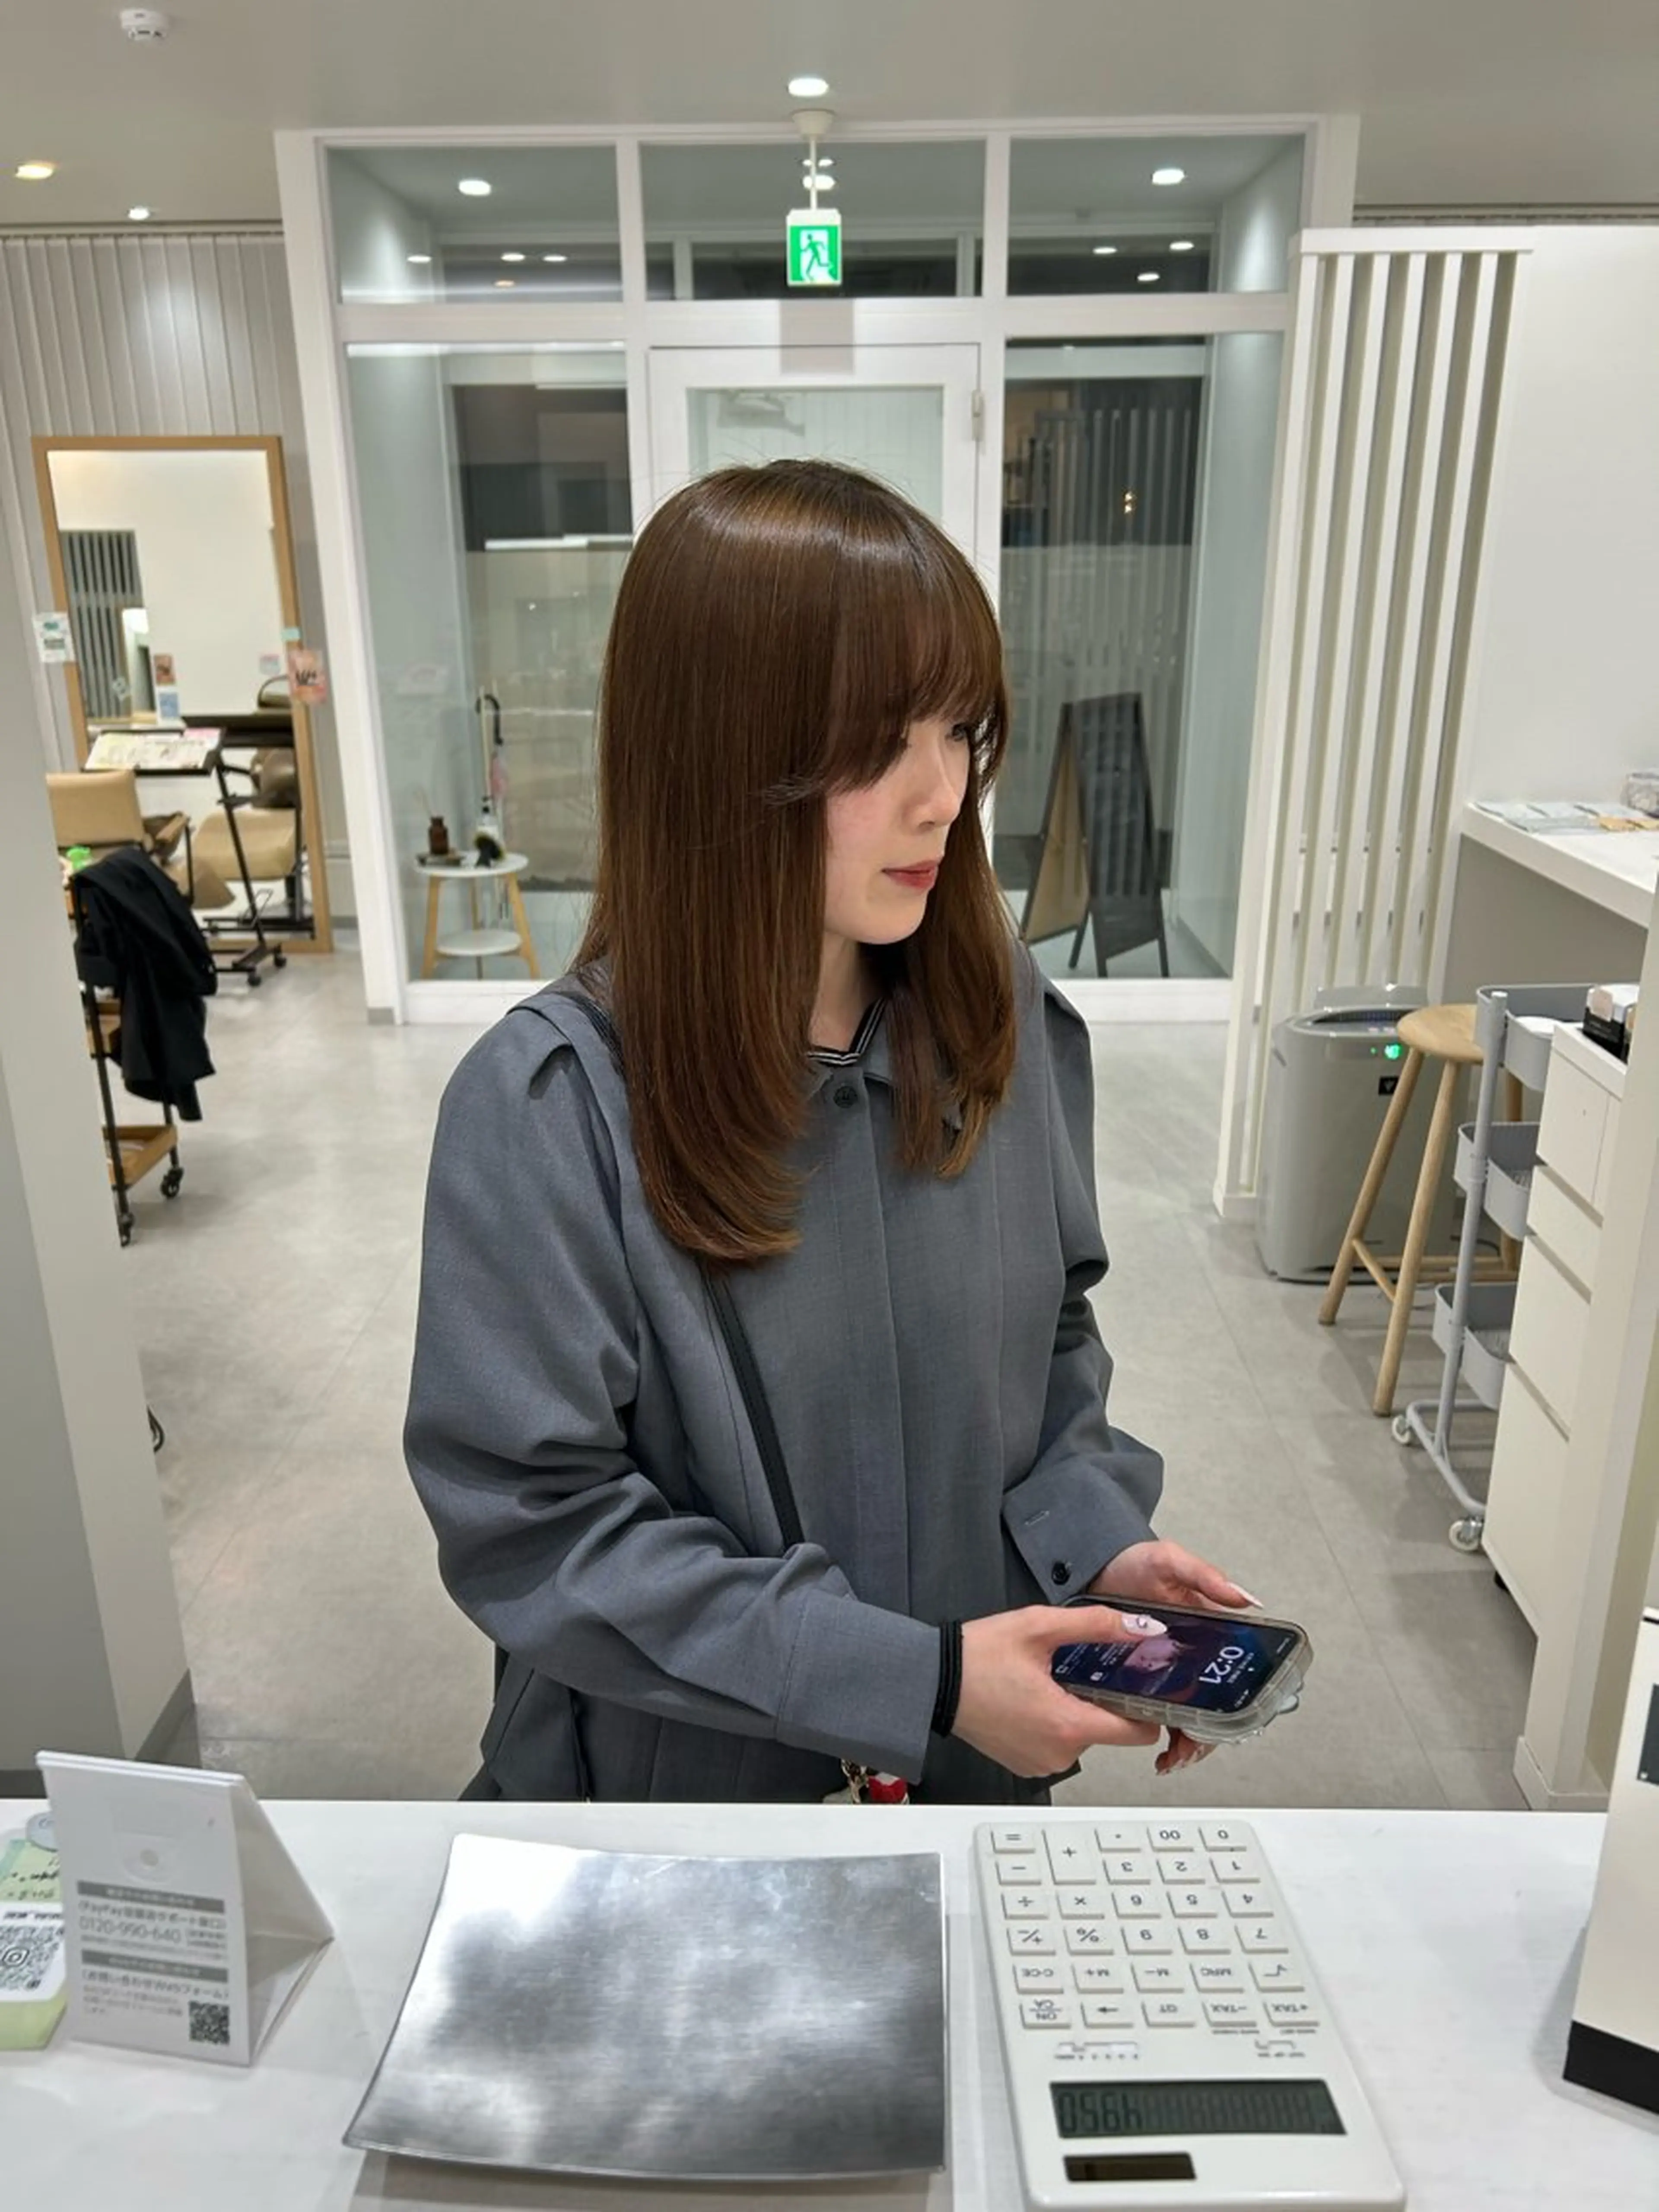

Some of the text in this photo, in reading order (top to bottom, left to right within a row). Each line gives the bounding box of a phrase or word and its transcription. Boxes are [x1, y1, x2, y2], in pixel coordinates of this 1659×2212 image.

[1199, 1646, 1245, 1684] 0:21
[1158, 1829, 1181, 1841] 00
[1217, 1829, 1230, 1840] 0
[1120, 1862, 1133, 1872] 3
[1174, 1861, 1188, 1872] 2
[1231, 1860, 1241, 1871] 1
[1130, 1894, 1143, 1906] 6
[1185, 1894, 1198, 1906] 5
[1242, 1894, 1253, 1904] 4
[78, 1915, 182, 1944] 0120-990-640
[1139, 1929, 1153, 1941] 9
[1196, 1928, 1210, 1940] 8
[1255, 1927, 1268, 1940] 7
[1200, 1967, 1232, 1977] MRC
[1159, 2003, 1178, 2014] GT
[1035, 2012, 1058, 2021] ON
[1057, 2091, 1143, 2134] 4950
